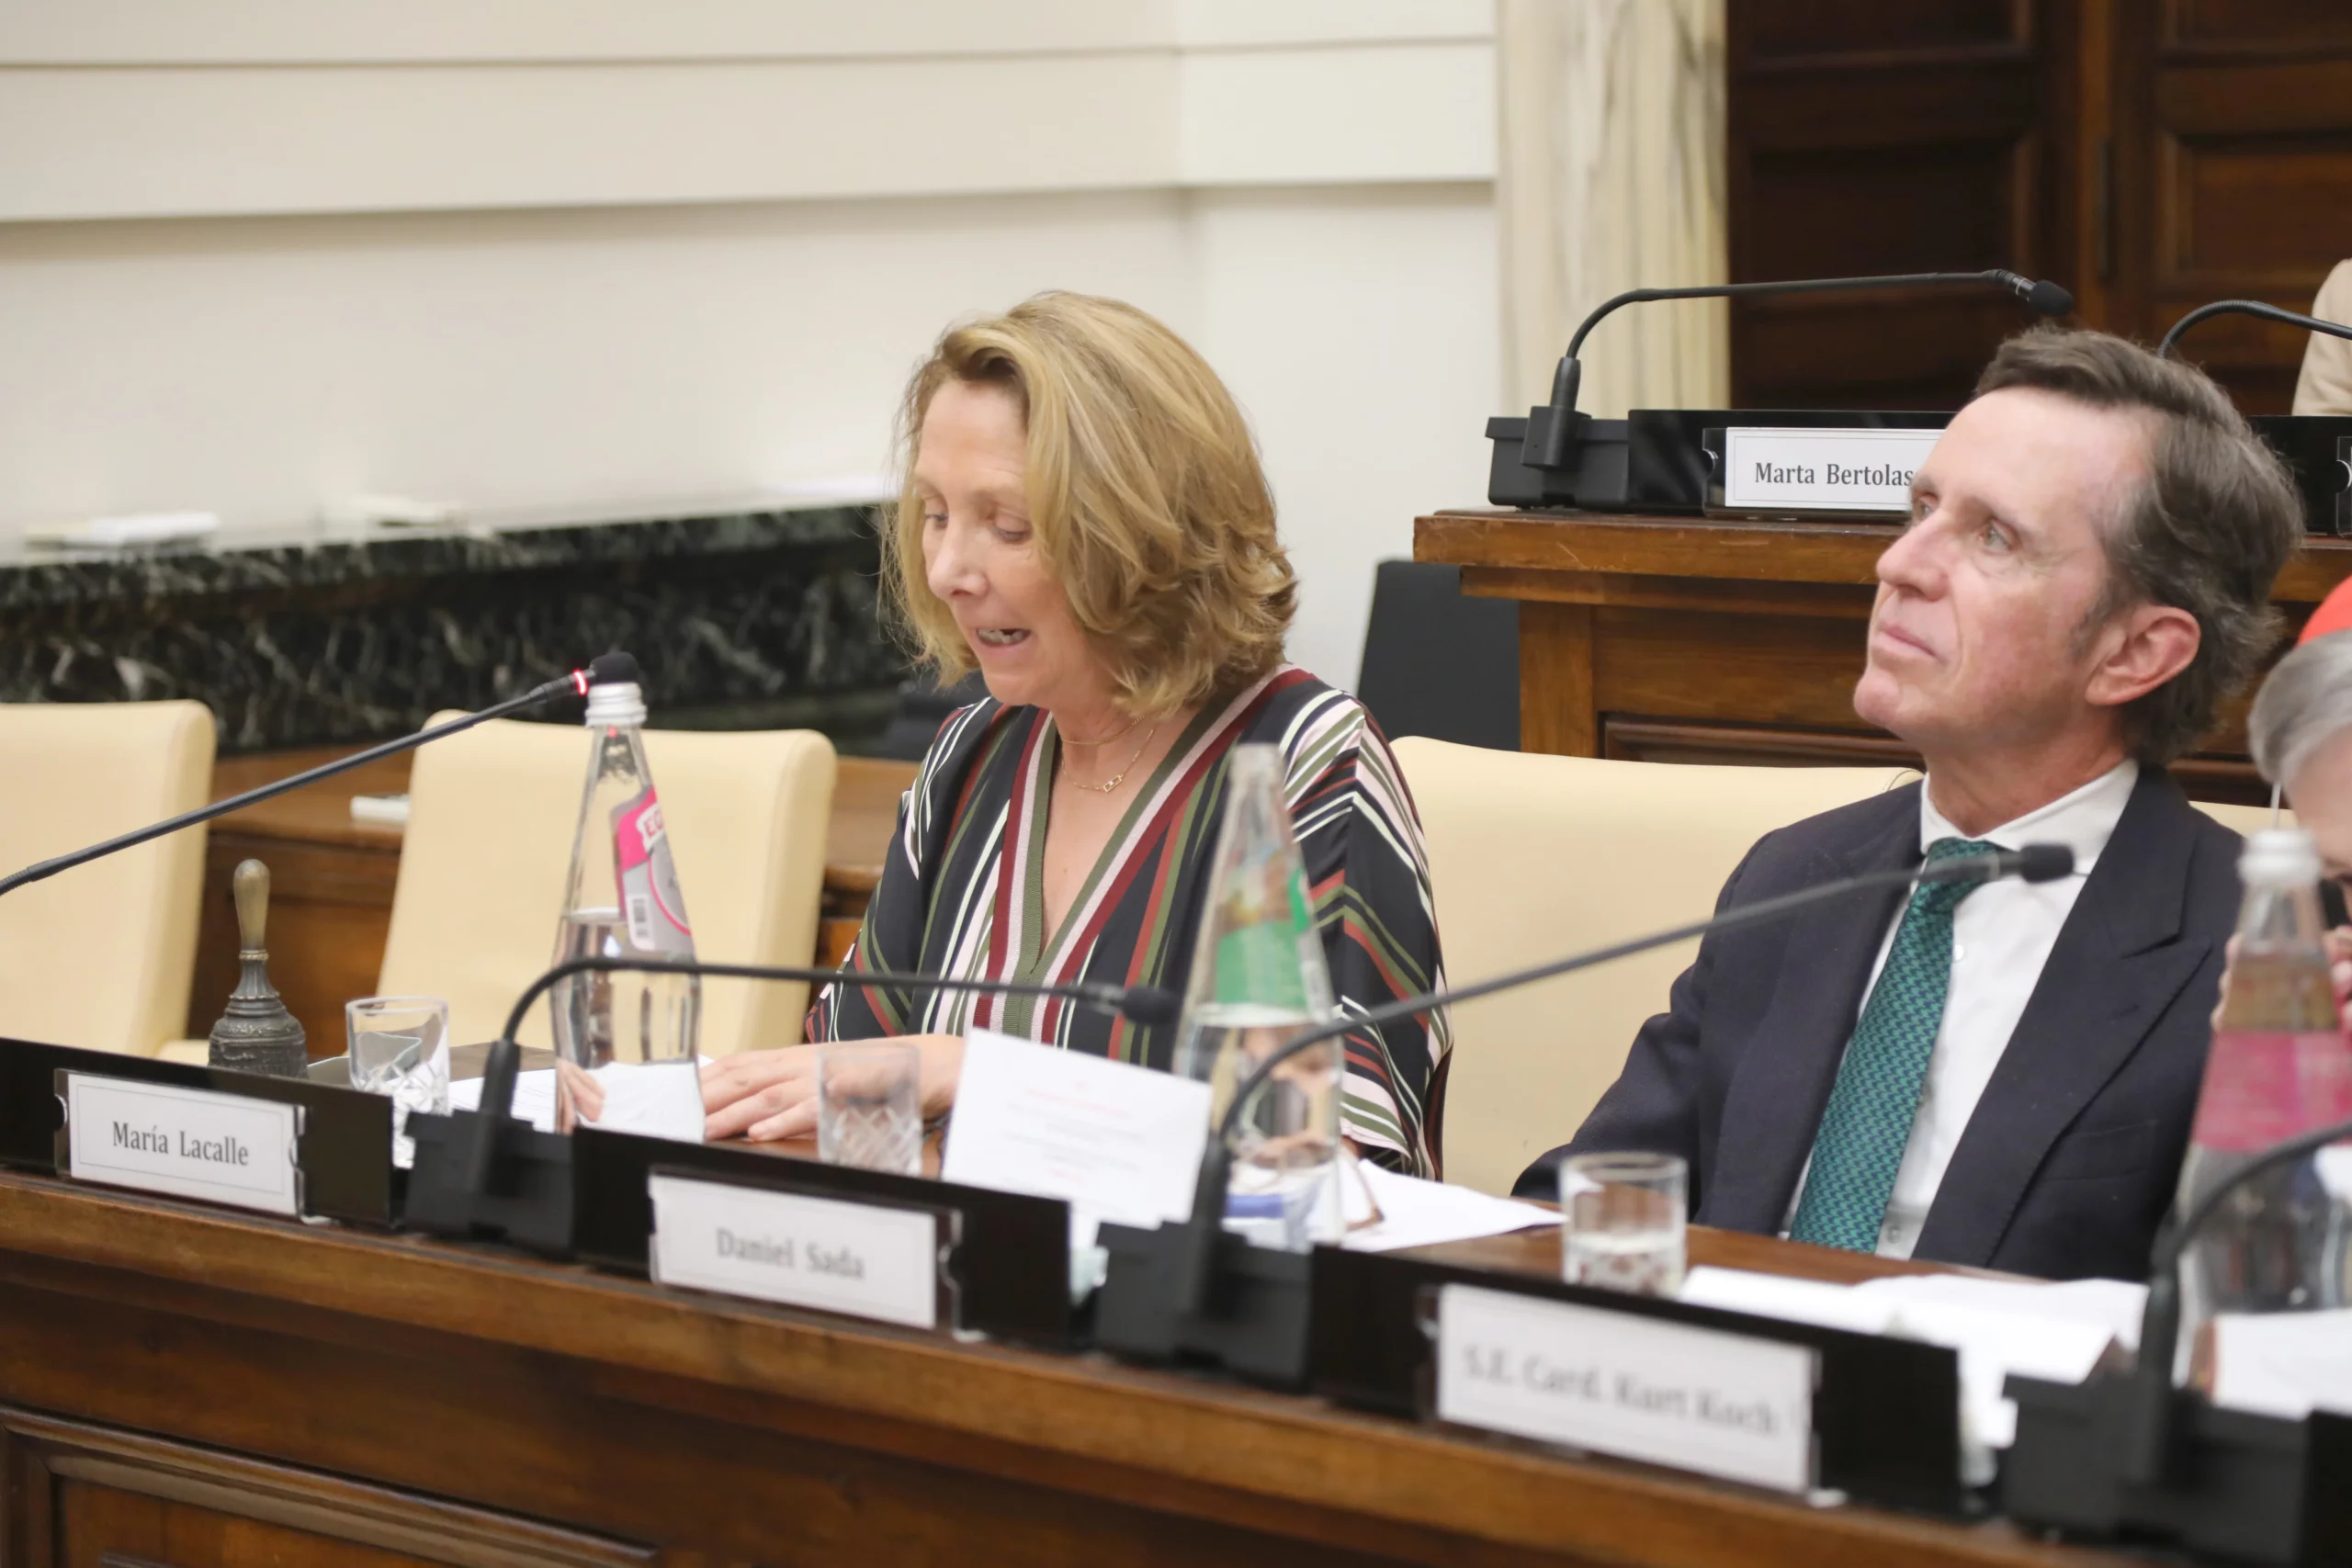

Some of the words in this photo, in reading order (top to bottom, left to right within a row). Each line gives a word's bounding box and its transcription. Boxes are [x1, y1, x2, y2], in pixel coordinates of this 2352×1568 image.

[1755, 462, 1815, 484] Marta
[1826, 463, 1917, 487] Bertolas
[112, 1120, 169, 1155] María
[179, 1130, 249, 1166] Lacalle
[716, 1226, 795, 1269] Daniel
[805, 1241, 866, 1280] Sada
